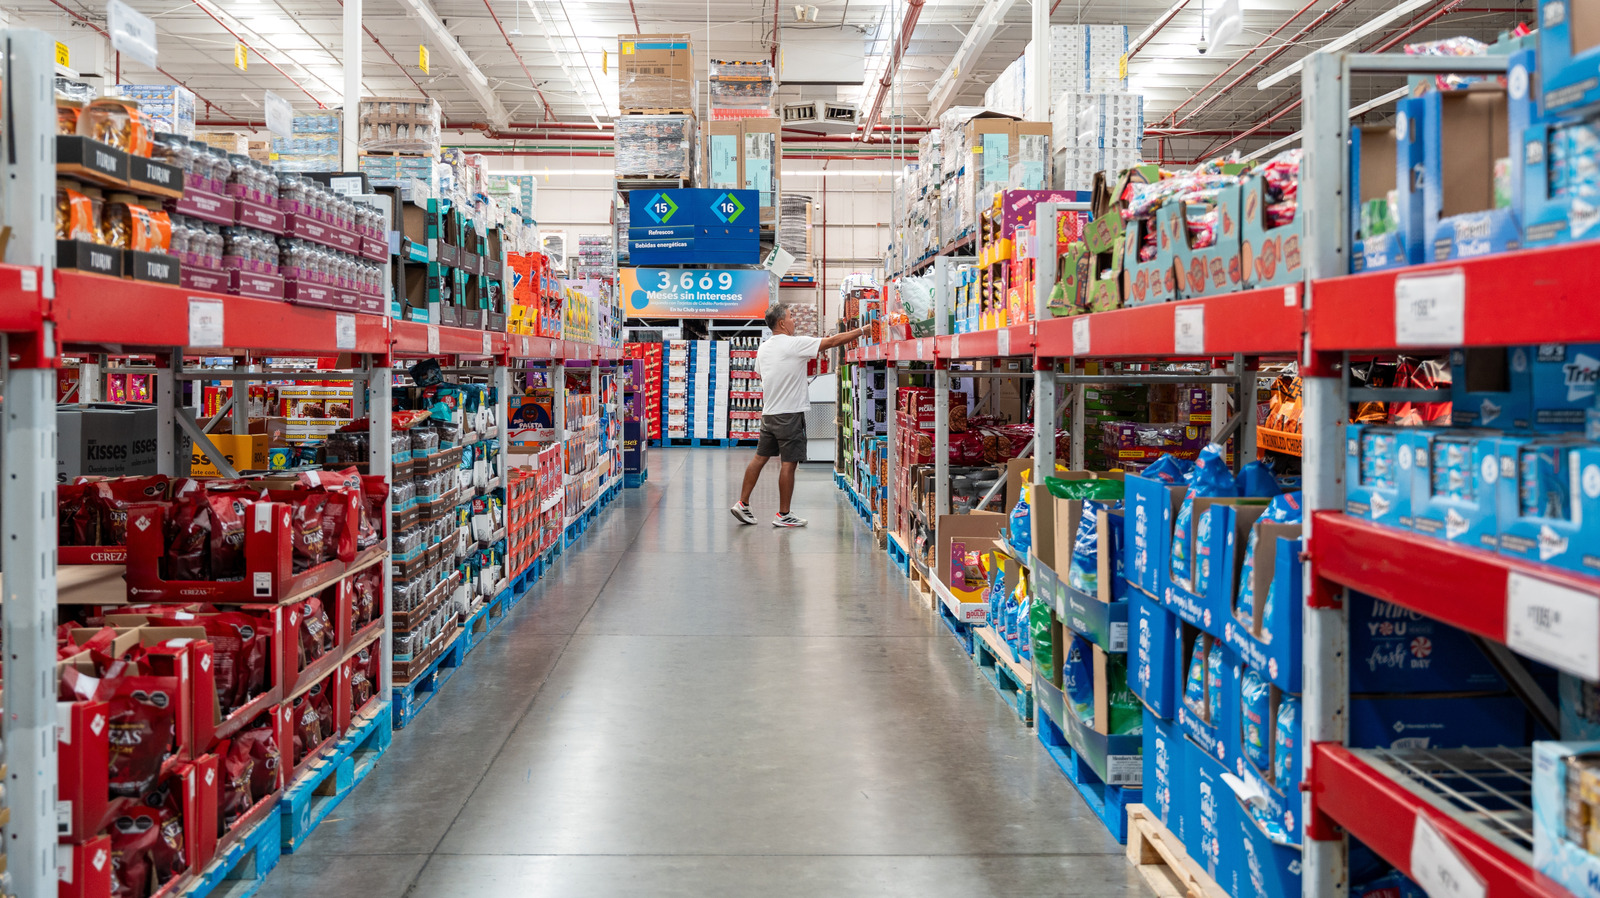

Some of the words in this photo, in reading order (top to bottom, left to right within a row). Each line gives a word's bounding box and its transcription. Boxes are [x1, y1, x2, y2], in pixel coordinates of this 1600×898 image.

[96, 150, 117, 171] TURIN
[147, 164, 171, 183] TURIN
[654, 203, 668, 213] 15
[720, 203, 734, 213] 16
[90, 251, 112, 270] TURIN
[147, 262, 169, 278] TURIN
[699, 272, 713, 290] ó
[718, 272, 733, 290] 9
[646, 290, 679, 300] Meses
[680, 291, 694, 300] sin
[696, 291, 743, 301] Intereses
[1262, 433, 1286, 450] WRINKLED
